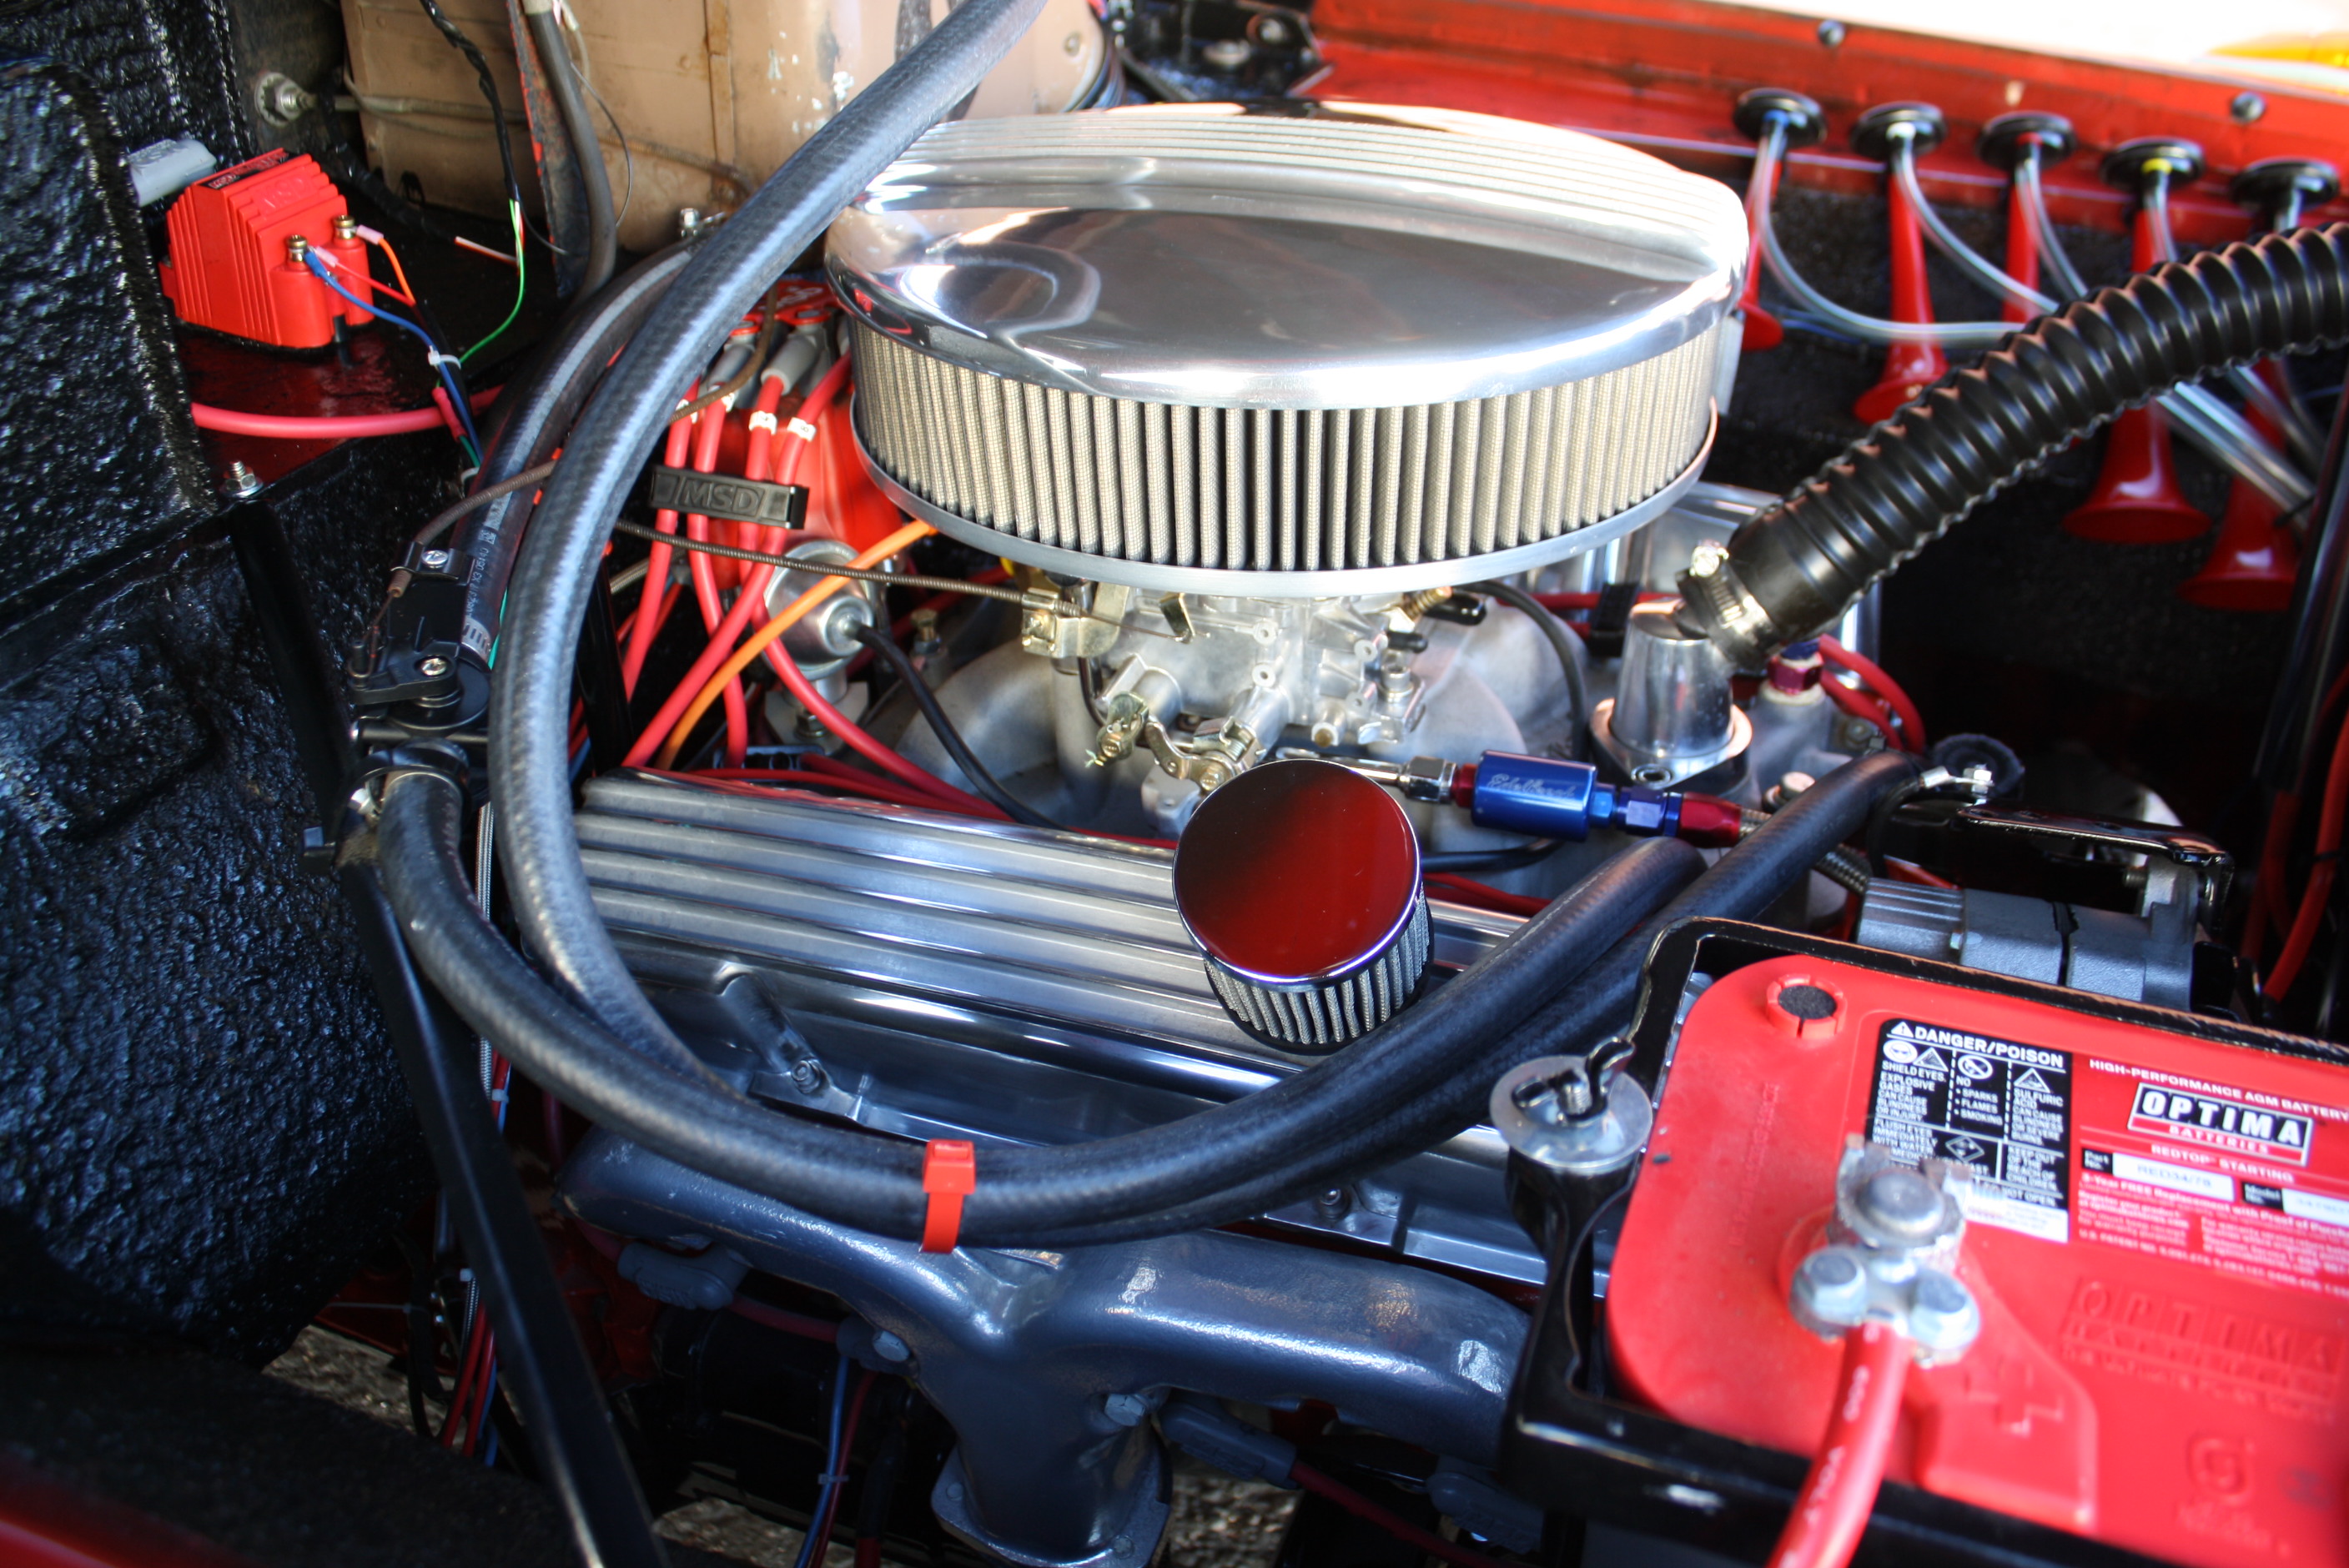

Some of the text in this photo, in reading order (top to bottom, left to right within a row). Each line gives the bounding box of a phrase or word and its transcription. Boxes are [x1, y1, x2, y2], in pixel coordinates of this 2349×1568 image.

[682, 477, 761, 516] MSD
[1915, 1027, 2064, 1068] DANGER/POISON
[1882, 1060, 1918, 1077] SHIELD
[1879, 1080, 1913, 1095] GASES
[1880, 1071, 1935, 1091] EXPLOSIVE
[1956, 1076, 1971, 1088] NO
[1878, 1088, 1927, 1107] CAN CAUSE
[1962, 1088, 1998, 1103] SPARKS
[2014, 1088, 2064, 1107] SULFURIC
[2089, 1059, 2349, 1123] HIGH-PERFORMANCE AGM BATTERY
[1875, 1104, 1889, 1113] OR
[1877, 1097, 1927, 1115] BLINDNESS
[1962, 1099, 1998, 1114] FLAMES
[2013, 1097, 2037, 1109] ACID
[1960, 1110, 2003, 1126] SMOKING
[2012, 1114, 2064, 1133] BLINDNESS
[2013, 1105, 2062, 1123] CAN CAUSE
[2141, 1090, 2301, 1146] OPTIMA
[1874, 1118, 1933, 1137] FLUSH EYES
[1874, 1126, 1938, 1148] IMMEDIATELY
[1872, 1134, 1898, 1148] WITH
[2169, 1126, 2269, 1154] BATTERIES
[2008, 1144, 2055, 1164] KEEP OUT
[2085, 1149, 2109, 1164] Part
[2220, 1158, 2293, 1183] STARTING
[2120, 1180, 2152, 1196] FREE
[2154, 1188, 2230, 1210] Replacement
[2232, 1206, 2259, 1219] with
[2260, 1210, 2294, 1226] Proof
